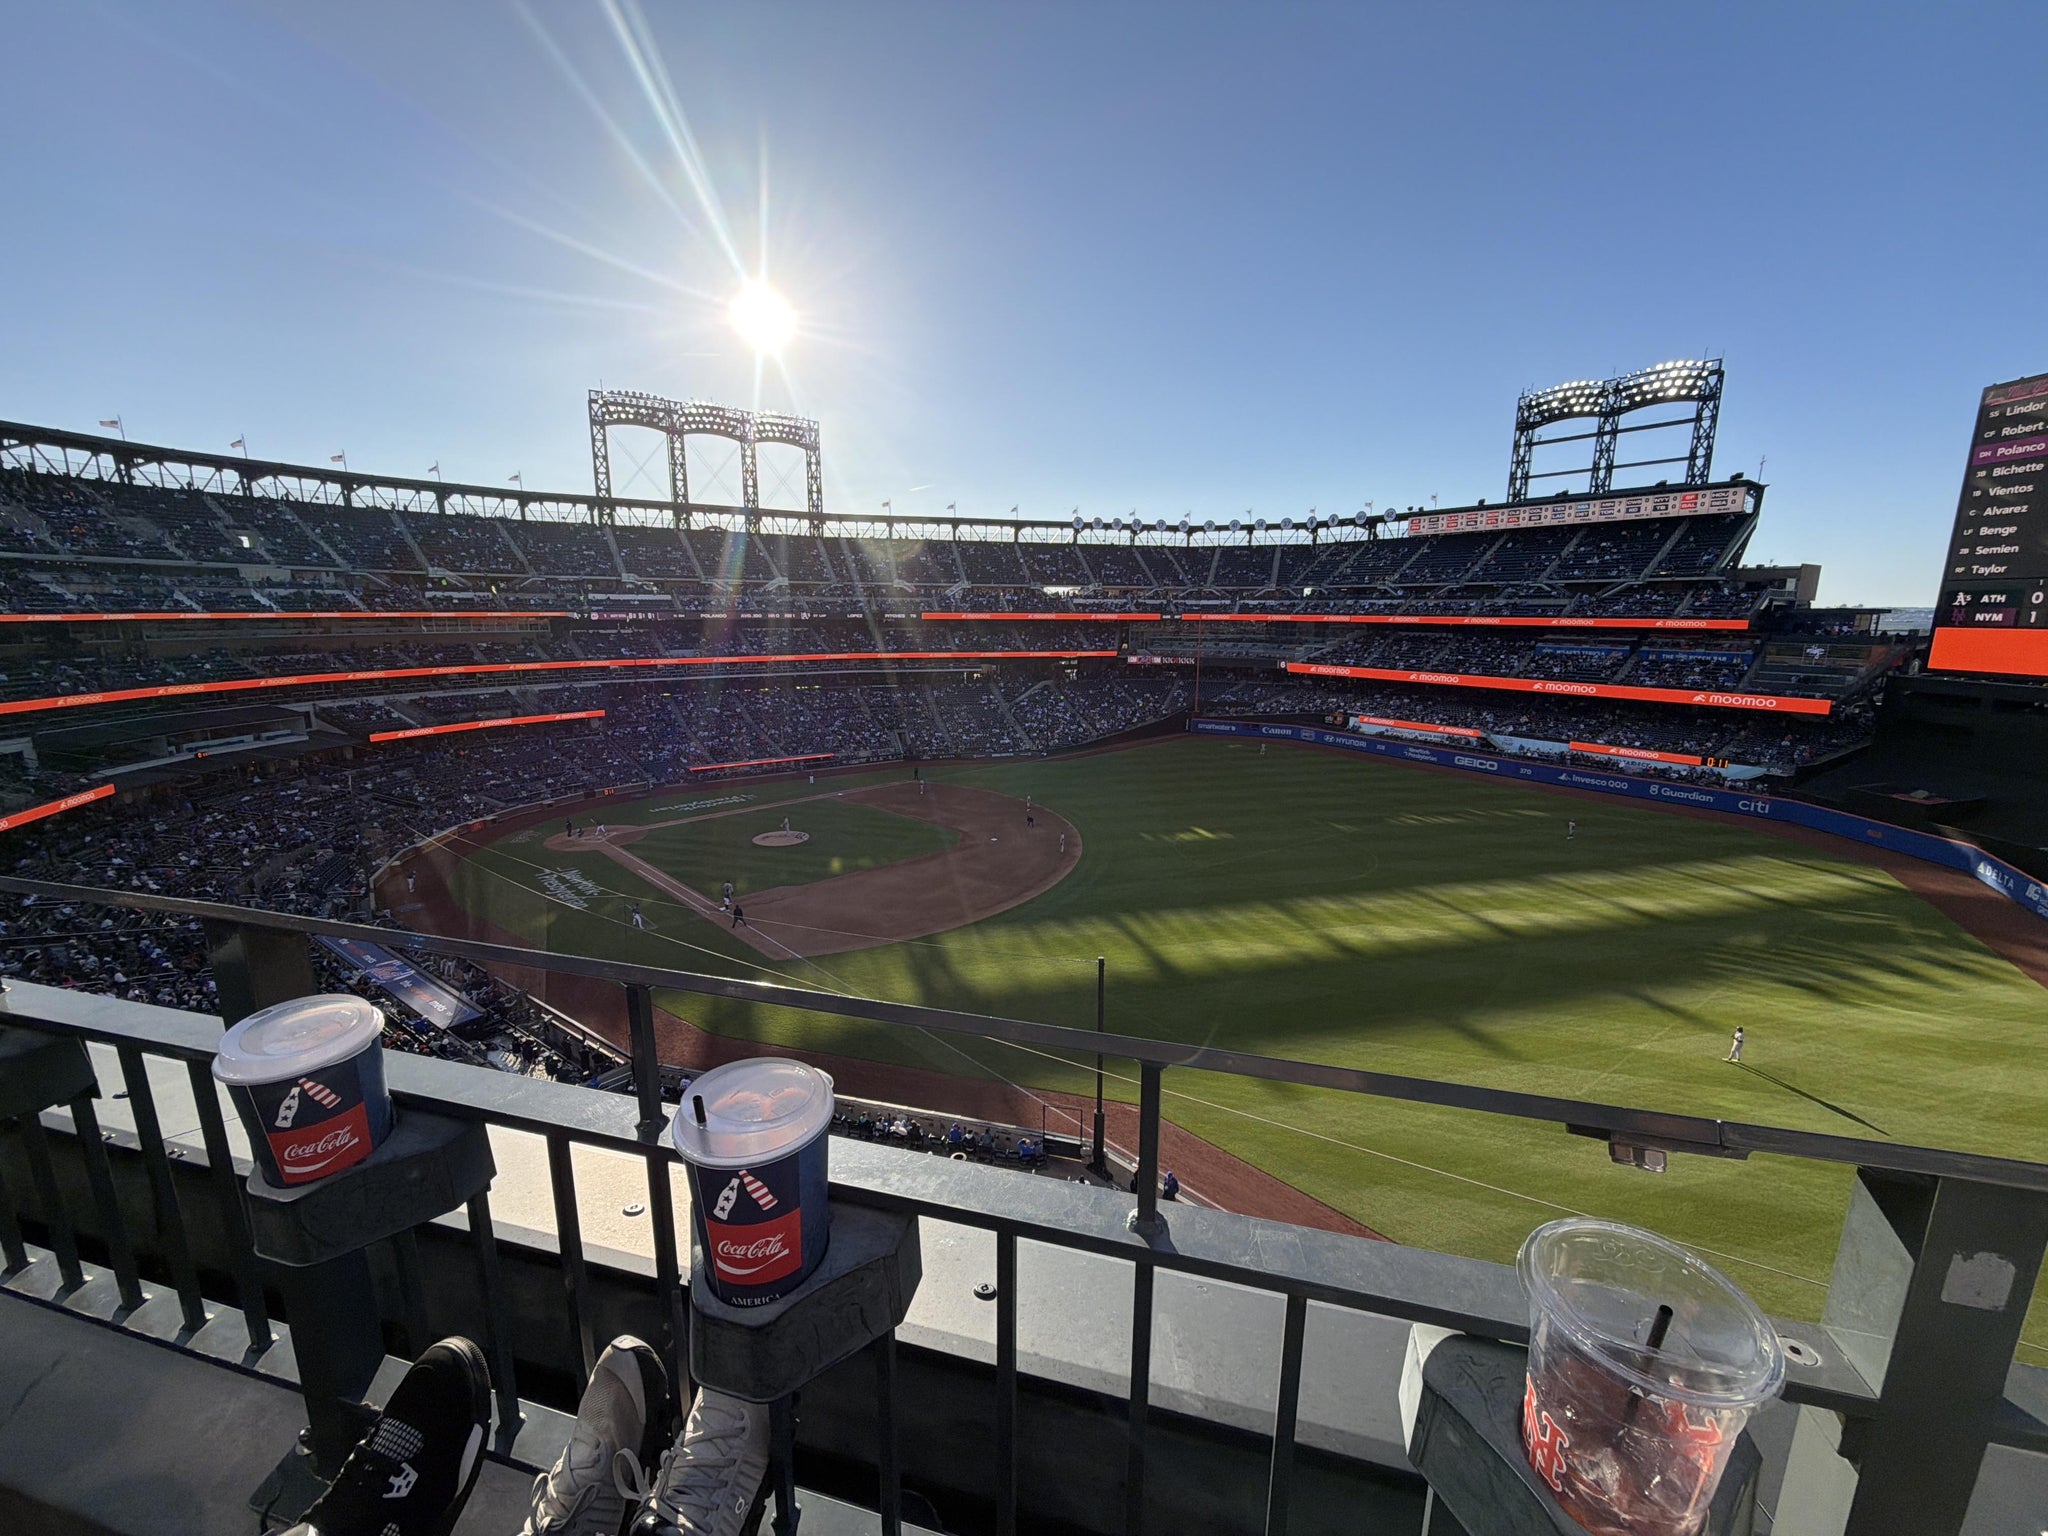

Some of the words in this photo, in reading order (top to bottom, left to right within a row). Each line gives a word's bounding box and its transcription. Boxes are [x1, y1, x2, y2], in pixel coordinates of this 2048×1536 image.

[2005, 401, 2046, 417] Lindor
[2001, 423, 2044, 437] Robert
[1996, 442, 2046, 457] Polanco
[1992, 462, 2044, 477] Bichette
[1988, 484, 2034, 496] Vientos
[1983, 503, 2029, 517] Alvarez
[1979, 525, 2018, 537] Benge
[1975, 544, 2020, 556] Semien
[1971, 564, 2008, 576] Taylor
[1980, 594, 2006, 603] ATH
[2031, 592, 2044, 604] 0
[1974, 612, 2003, 623] NYM
[2029, 611, 2037, 623] 1
[1666, 620, 1707, 628] moomoo
[1318, 666, 1351, 676] moomoo
[1419, 672, 1460, 683] moomoo
[1545, 682, 1597, 694] moomoo
[67, 695, 103, 704] moomoo
[1709, 694, 1777, 709] moomoo
[1262, 726, 1291, 736] Canon
[1335, 737, 1367, 749] HYUNDAI
[1618, 748, 1659, 759] moomoo
[1454, 755, 1498, 771] GEICO
[1707, 757, 1729, 768] 0:11
[1572, 773, 1607, 786] Invesco
[67, 792, 95, 807] moomoo
[1660, 787, 1714, 803] Guardian
[1986, 865, 2015, 890] DELTA
[284, 1124, 352, 1161] Coca-Cola
[718, 1232, 785, 1259] Coca-Cola
